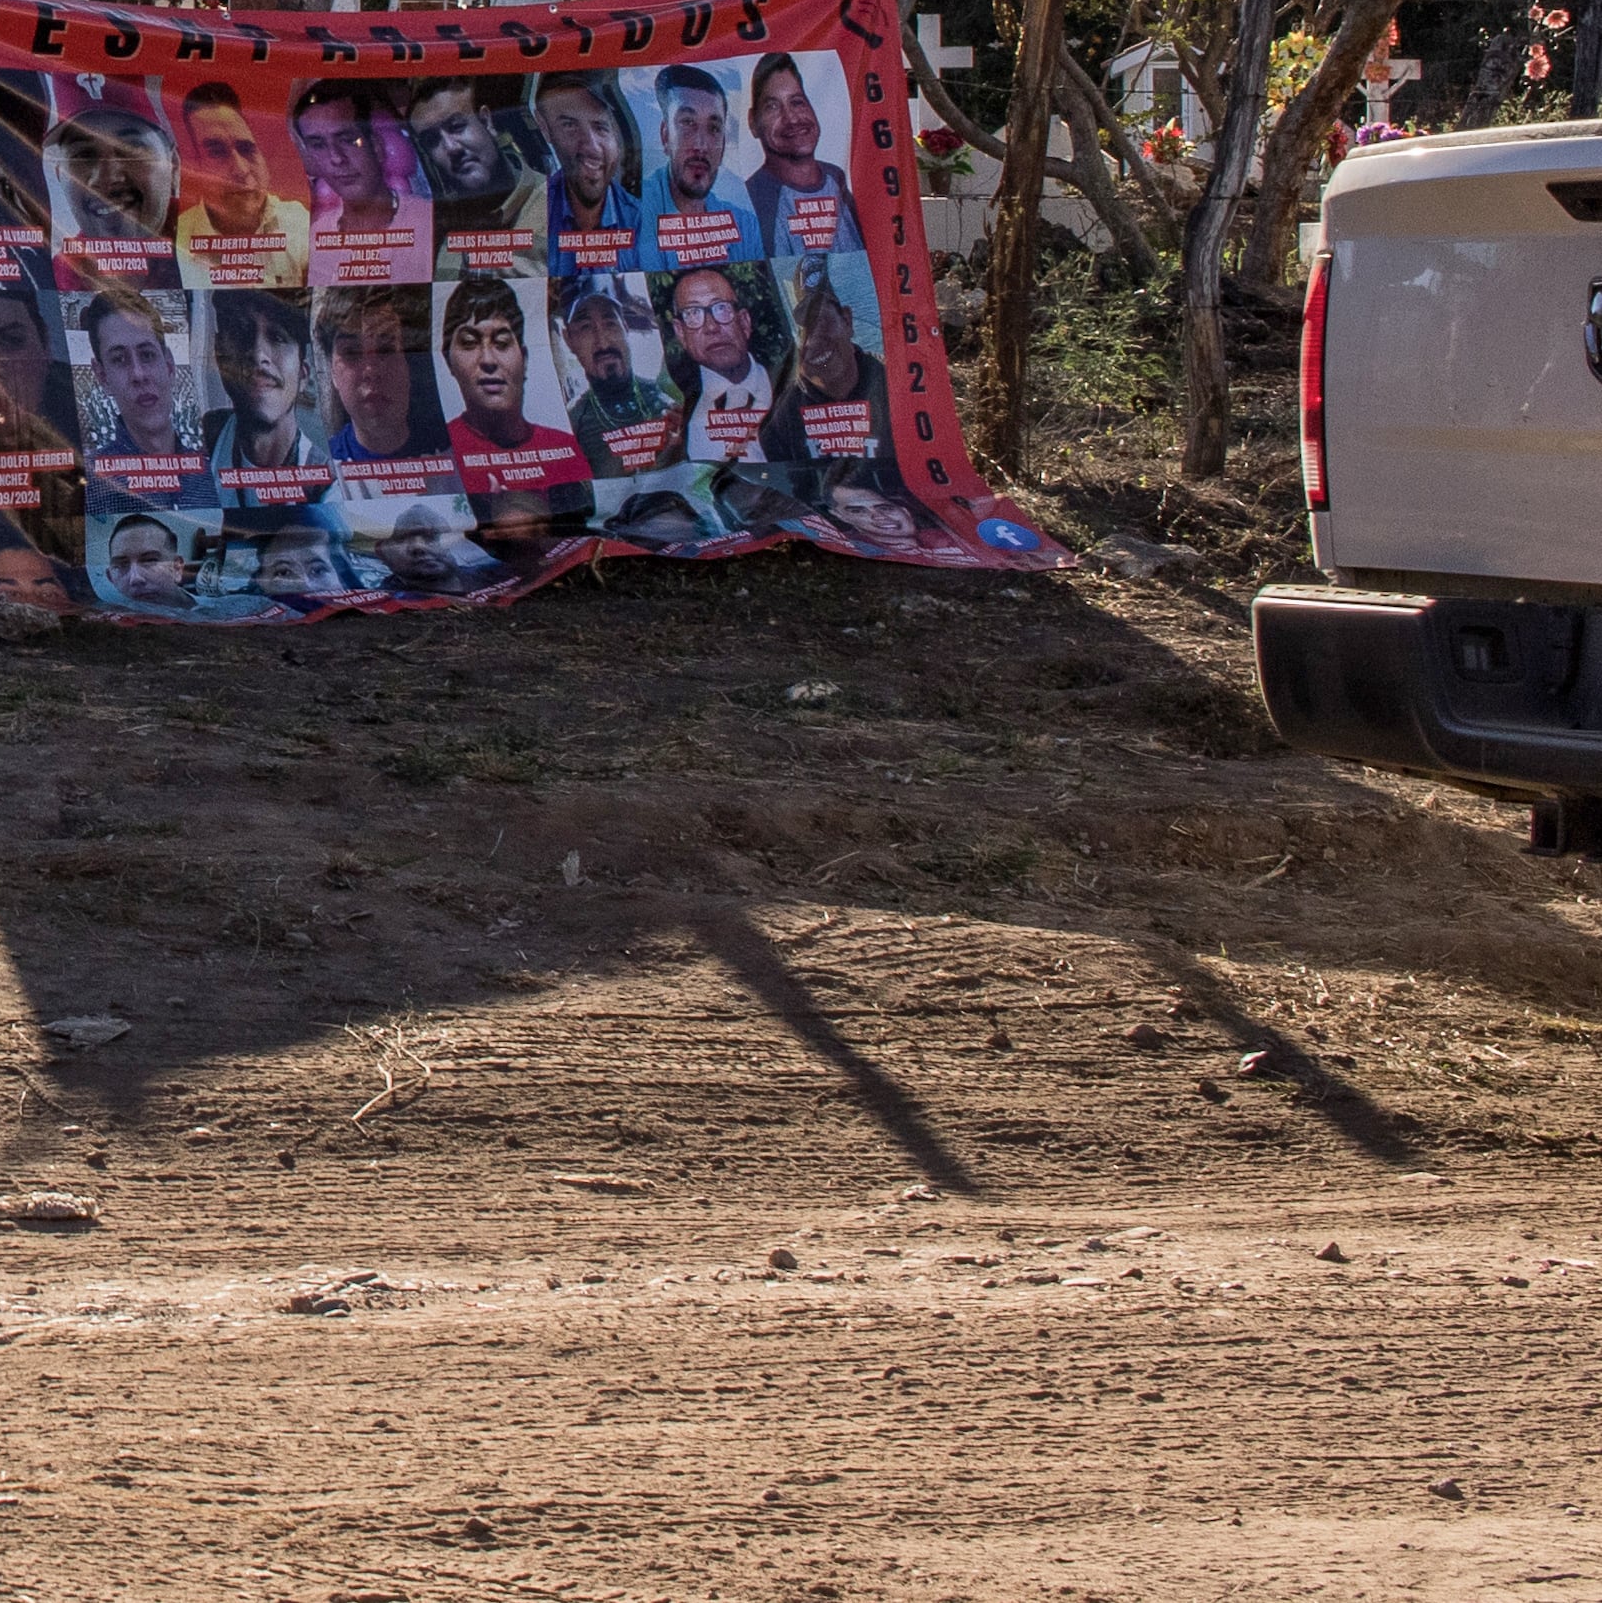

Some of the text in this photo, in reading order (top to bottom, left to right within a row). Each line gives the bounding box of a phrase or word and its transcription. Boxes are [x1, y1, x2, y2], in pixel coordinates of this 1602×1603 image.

[798, 201, 820, 214] JUAN
[659, 214, 732, 230] MIGUEL ALEJANDRO
[3, 229, 43, 242] ALVARADO
[190, 236, 286, 249] LUIS ALBERTO RICARDO
[315, 232, 414, 248] JORGE ARMANDO RAMOS
[447, 235, 476, 248] CARLOS
[477, 233, 511, 247] FAJARDO
[558, 234, 584, 247] RAFAEL
[612, 230, 632, 245] PÉREZ
[658, 229, 739, 247] VALDEZ MALDONADO
[63, 240, 173, 254] LUIS ALEXIS PERAZA TORRES
[221, 252, 255, 265] ALONSO
[351, 249, 381, 261] VALDEZ
[803, 403, 866, 420] JUAN FEDERICO
[805, 420, 851, 435] GRANADOS
[32, 452, 75, 467] HERRERA
[94, 456, 202, 472] ALEJANDRO TRUJILLO CRUZ
[462, 454, 491, 467] MIGUEL
[513, 451, 539, 464] ALZATE
[539, 447, 576, 462] MENDOZA
[373, 463, 393, 475] ALAN
[393, 462, 424, 474] MORENO
[425, 460, 454, 472] SOLANO
[220, 469, 239, 484] JOSÉ
[240, 471, 276, 483] GERARDO
[295, 467, 330, 481] SÁNCHEZ
